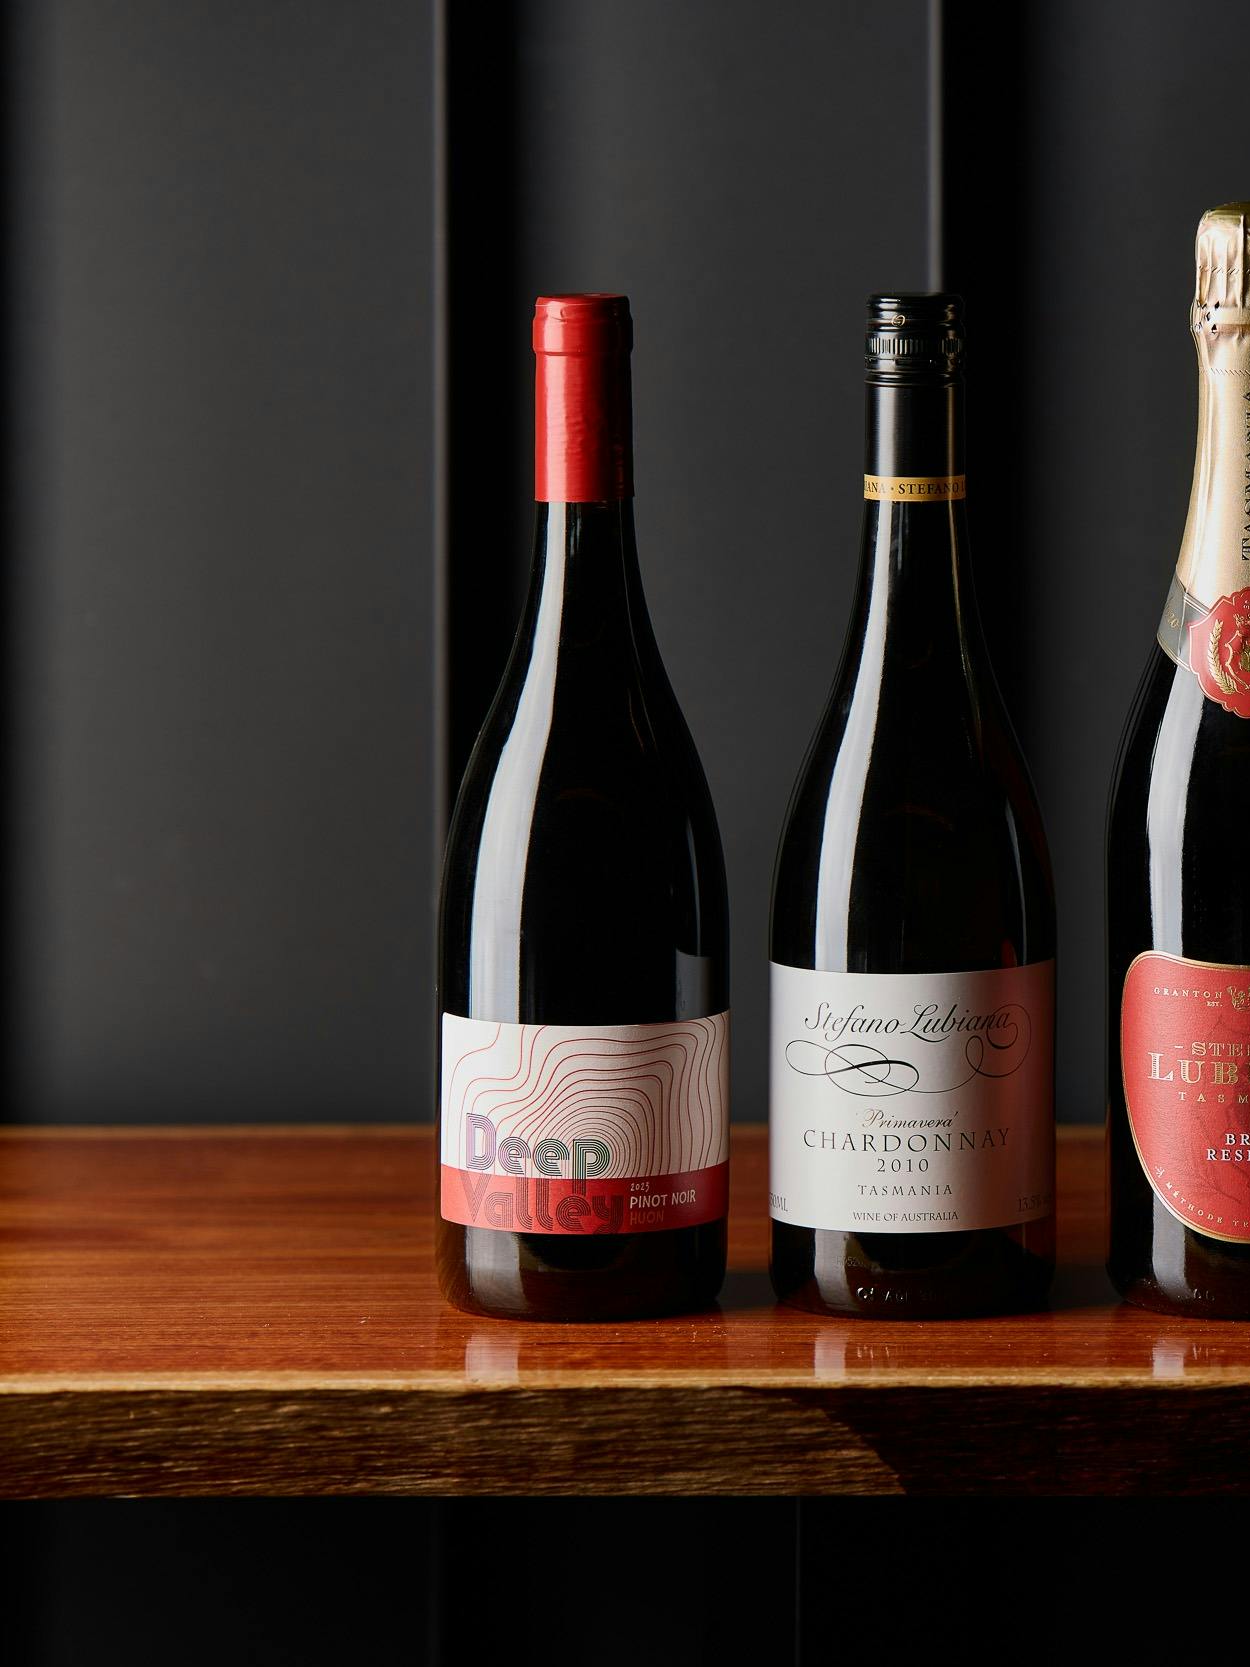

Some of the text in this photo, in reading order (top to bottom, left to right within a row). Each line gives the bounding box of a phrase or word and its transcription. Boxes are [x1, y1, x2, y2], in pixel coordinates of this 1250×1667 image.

[898, 483, 959, 495] STEFANO
[1153, 987, 1223, 999] GRANTON
[804, 1001, 1014, 1047] Stefano Lubiana
[802, 1128, 1010, 1153] CHARDONNAY
[466, 1113, 611, 1197] Deep
[877, 1158, 929, 1173] 2010
[857, 1184, 953, 1196] TASMANIA
[458, 1168, 625, 1235] Valley
[629, 1189, 696, 1209] PINOT NOIR
[630, 1211, 665, 1226] HUON
[853, 1211, 960, 1222] WINE OF AUSTRALIA
